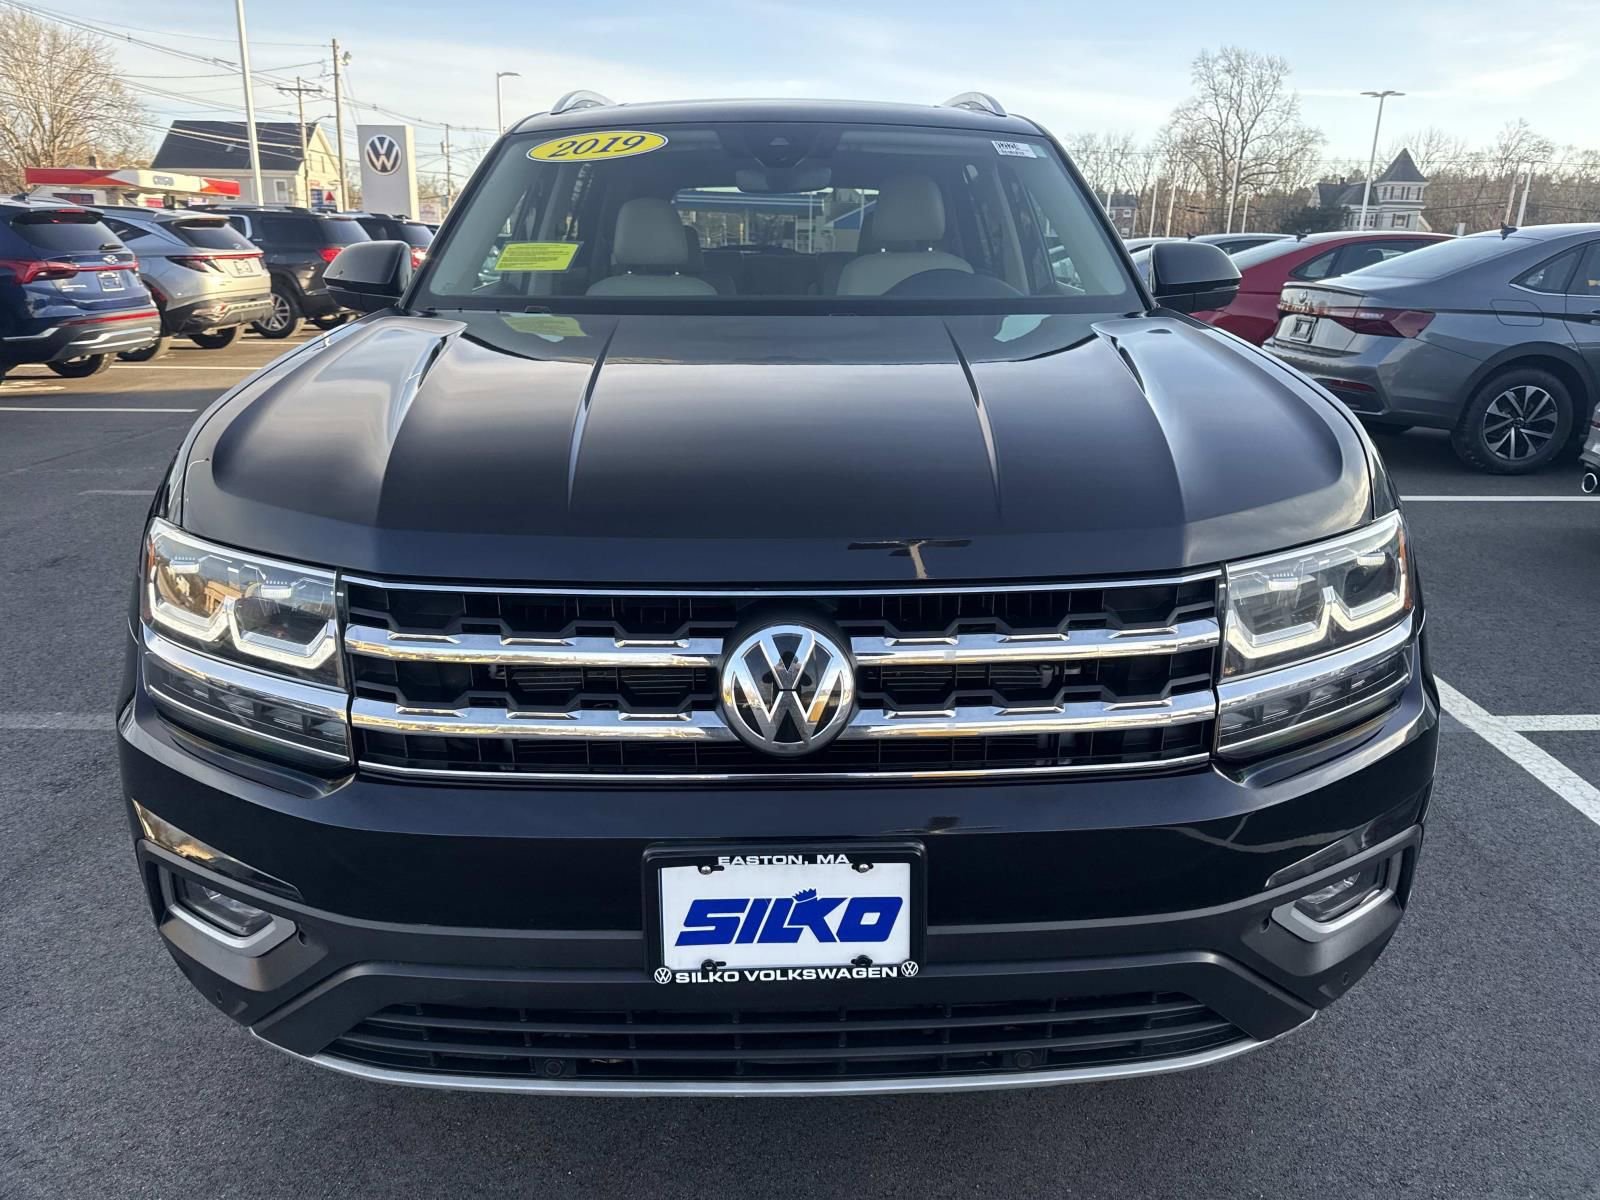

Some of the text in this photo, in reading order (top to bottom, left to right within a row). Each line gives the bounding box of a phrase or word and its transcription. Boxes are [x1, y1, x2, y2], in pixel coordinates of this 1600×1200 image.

[365, 135, 402, 176] VW
[547, 135, 646, 158] 2019
[722, 624, 855, 755] VW
[717, 854, 851, 867] EASTON, MA
[674, 895, 904, 947] SILKO
[674, 970, 741, 984] SILKO
[743, 966, 898, 982] VOLKSWAGEN
